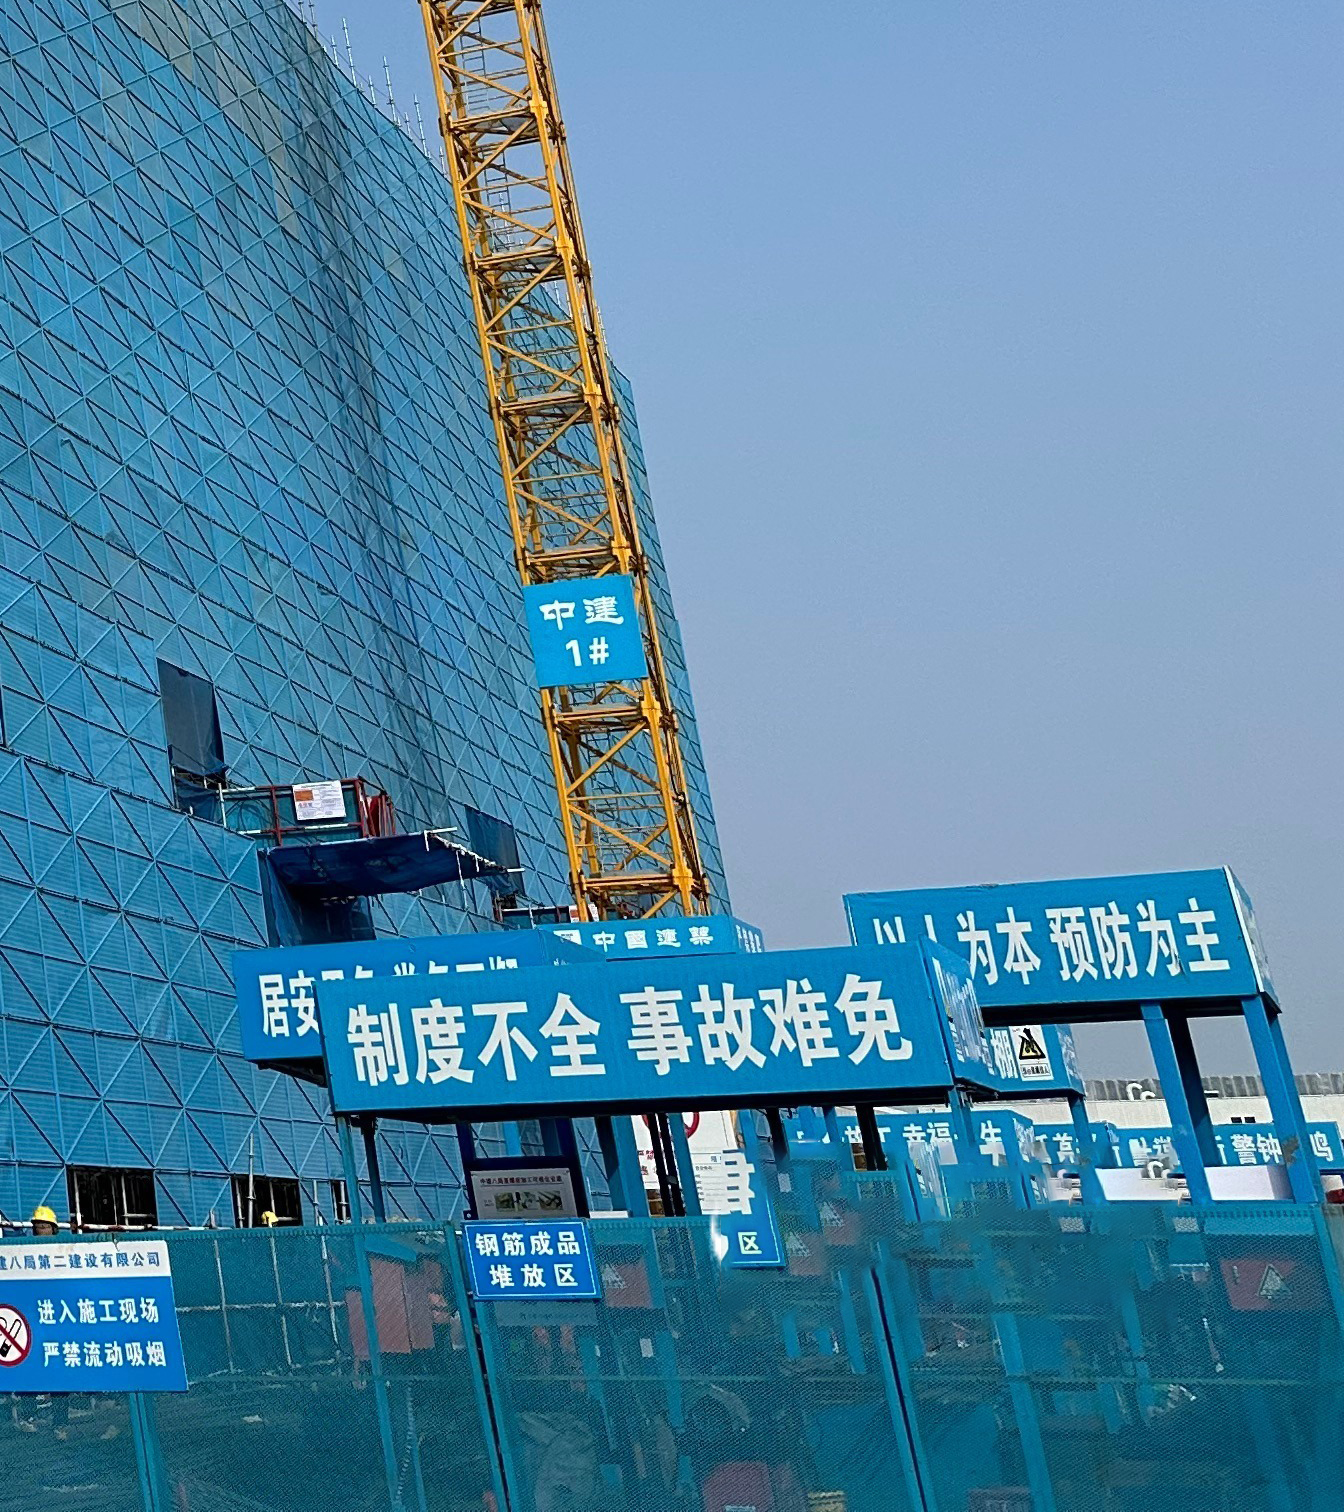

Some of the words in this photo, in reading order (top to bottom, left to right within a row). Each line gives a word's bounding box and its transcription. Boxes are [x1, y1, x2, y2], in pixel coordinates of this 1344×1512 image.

[538, 595, 624, 631] 中建
[565, 636, 610, 667] 1#
[1046, 897, 1231, 985] 预防为主
[346, 992, 606, 1088] 制度不全
[619, 973, 914, 1076] 事故难免
[475, 1230, 582, 1257] 钢筋成品
[489, 1263, 579, 1290] 堆放区
[37, 1297, 160, 1325] 进入施工现场
[42, 1340, 167, 1368] 严禁流动吸烟
